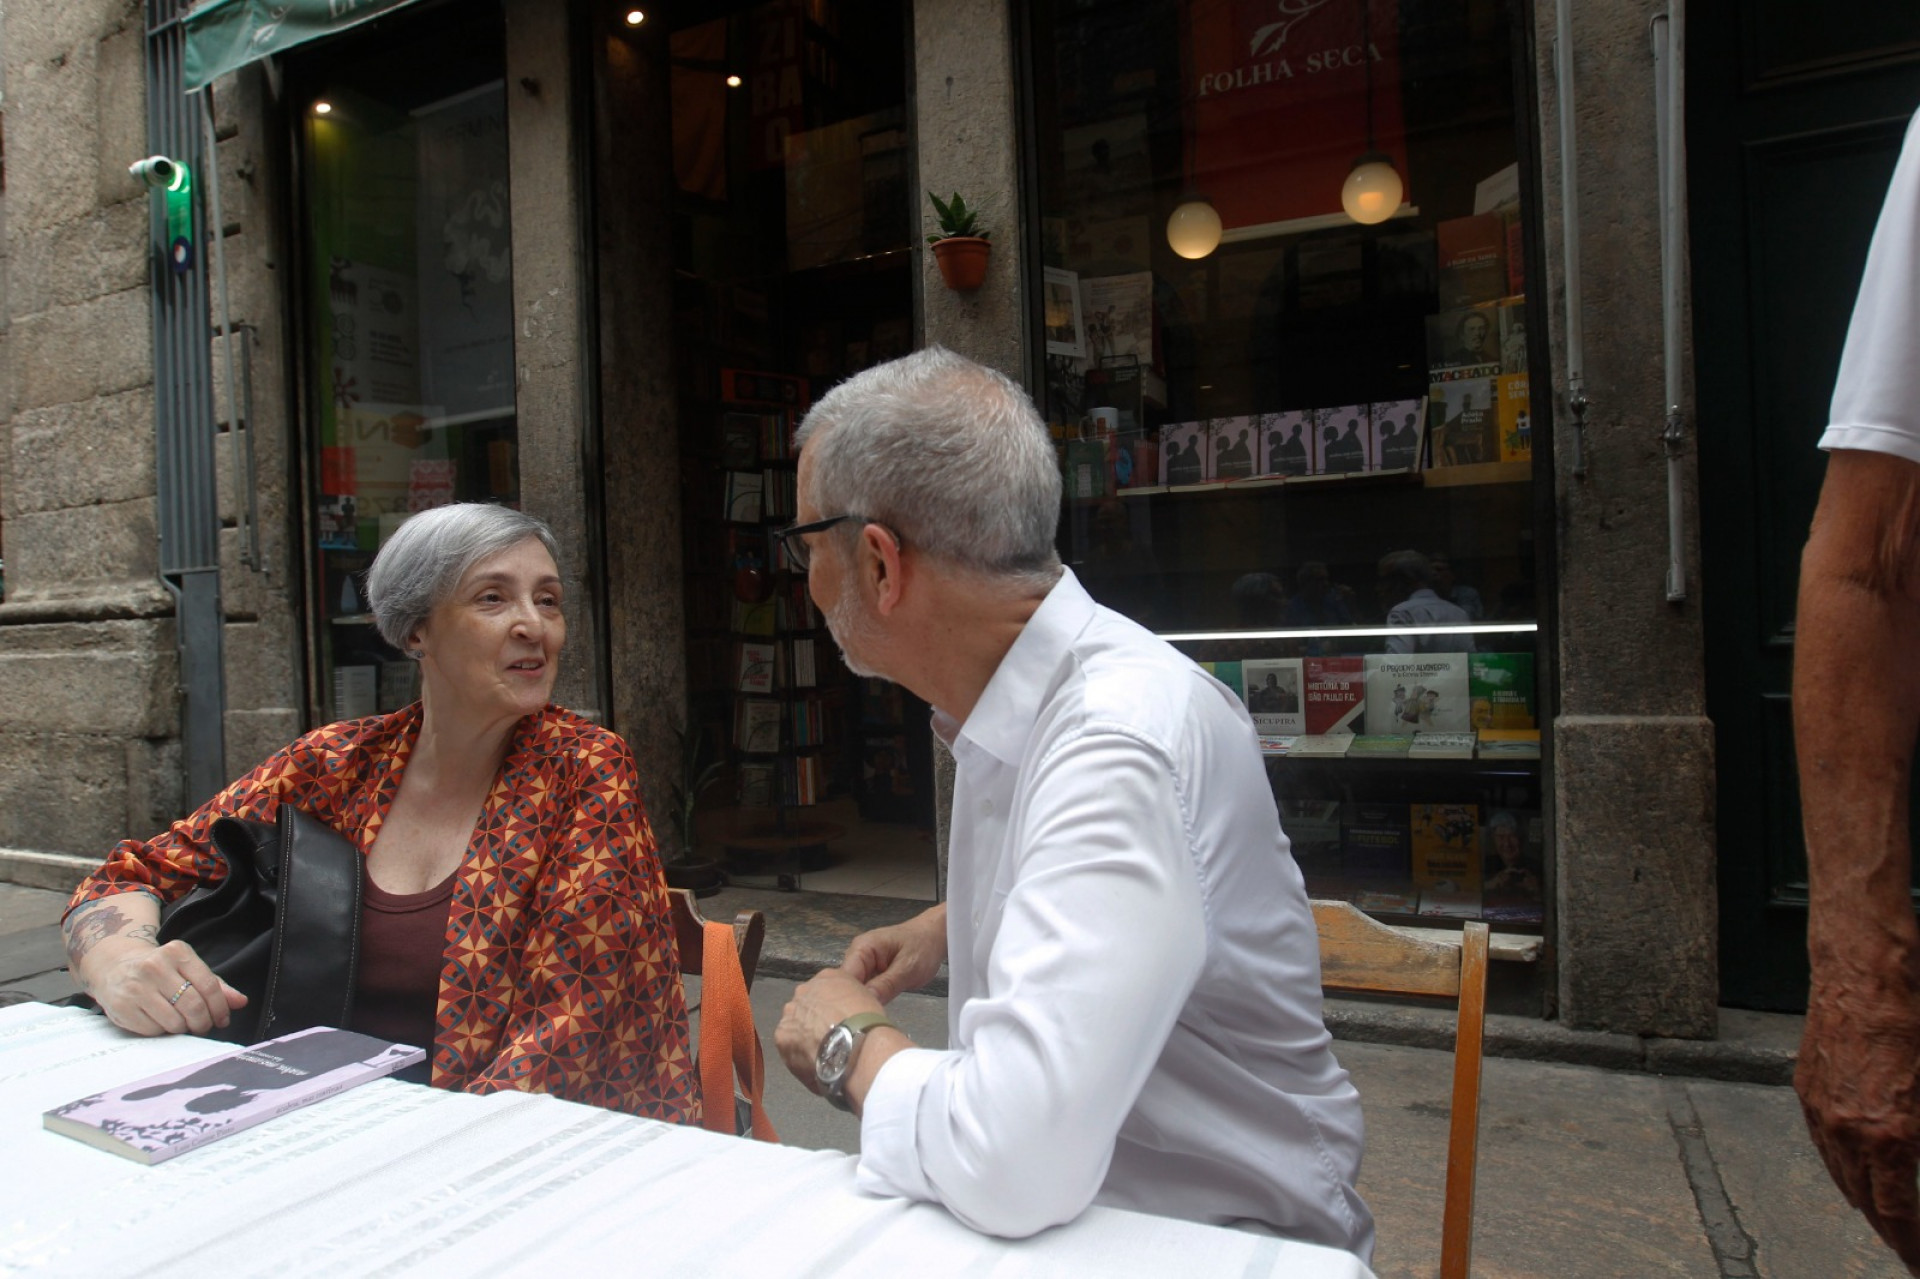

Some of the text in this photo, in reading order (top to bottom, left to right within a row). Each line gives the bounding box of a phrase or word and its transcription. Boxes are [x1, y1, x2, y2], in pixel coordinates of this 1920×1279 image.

[1198, 42, 1384, 97] FOLHA SECA
[1429, 365, 1502, 384] MACHADO
[1323, 692, 1344, 702] PAULO
[1253, 716, 1296, 725] SICUPIRA
